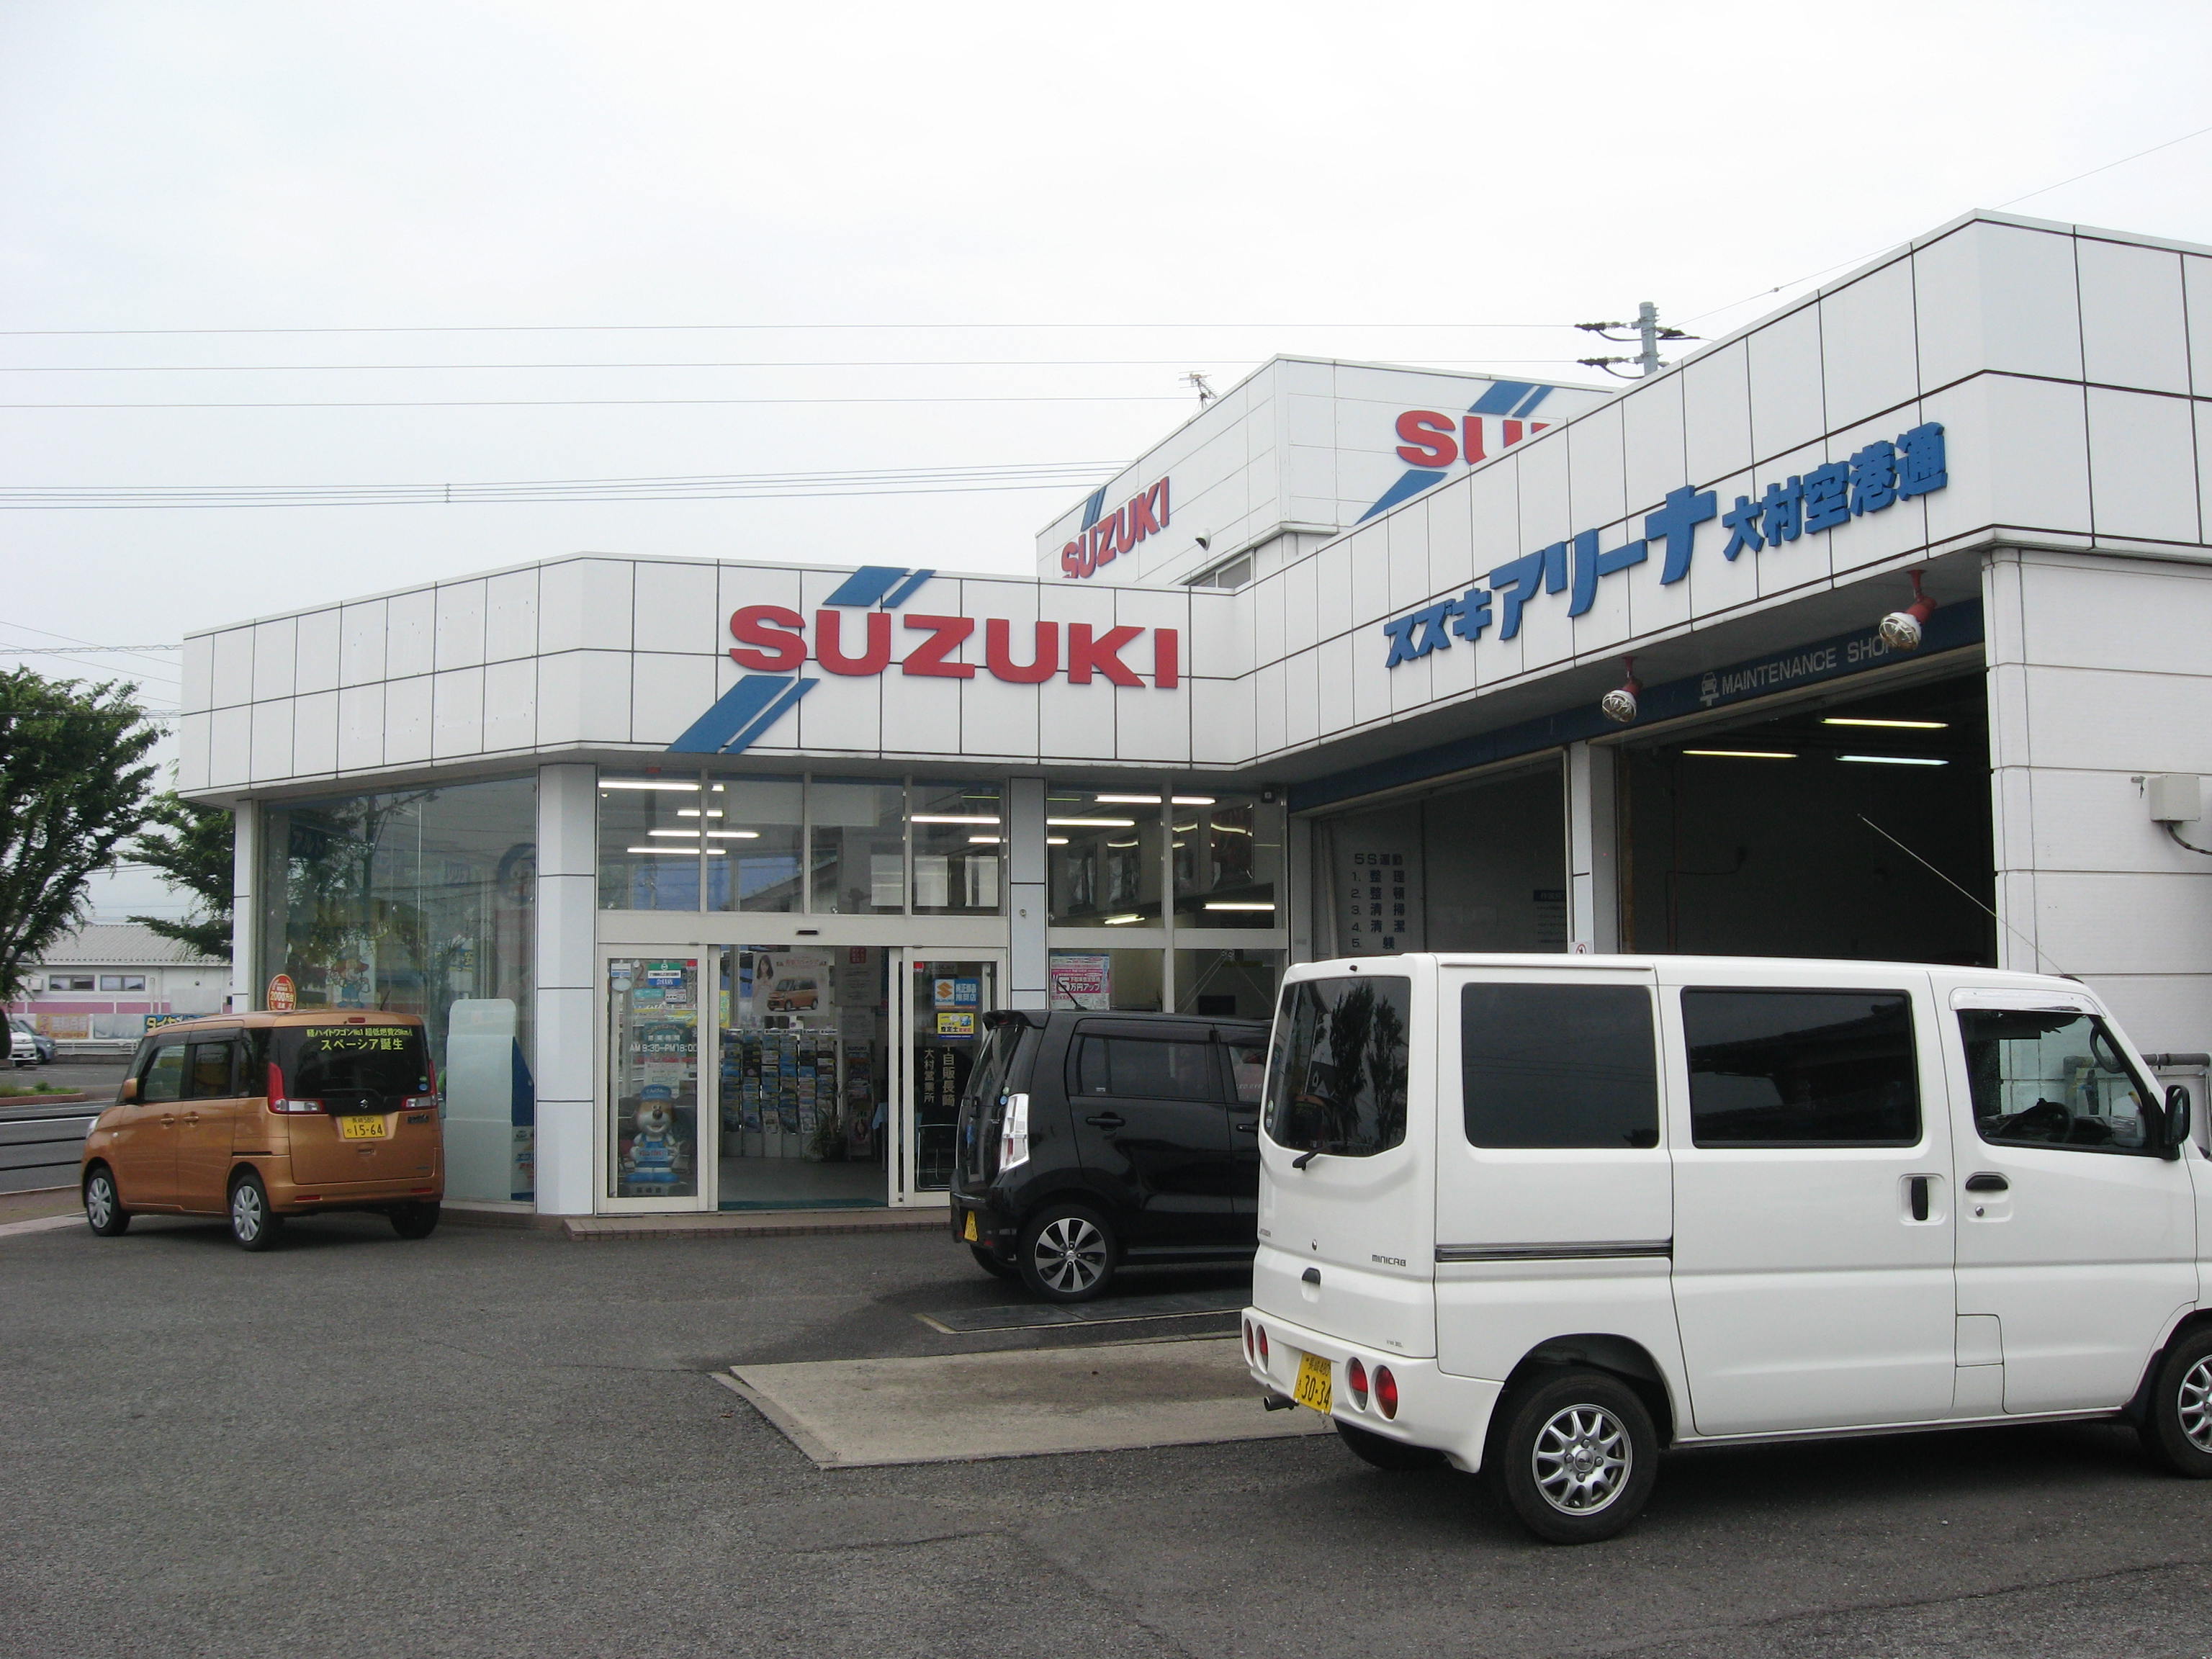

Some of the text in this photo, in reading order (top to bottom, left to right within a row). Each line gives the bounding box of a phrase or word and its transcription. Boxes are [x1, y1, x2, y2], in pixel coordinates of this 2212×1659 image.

[1061, 476, 1170, 579] SUZUKI
[1384, 421, 1948, 668] スズキアリーナ 大村空港通
[729, 605, 1178, 688] SUZUKI
[1722, 635, 1889, 695] MAINTENANCE SHO
[354, 1124, 383, 1136] 15-64
[1372, 1254, 1406, 1267] MINICAB
[1301, 1375, 1331, 1408] 30-34
